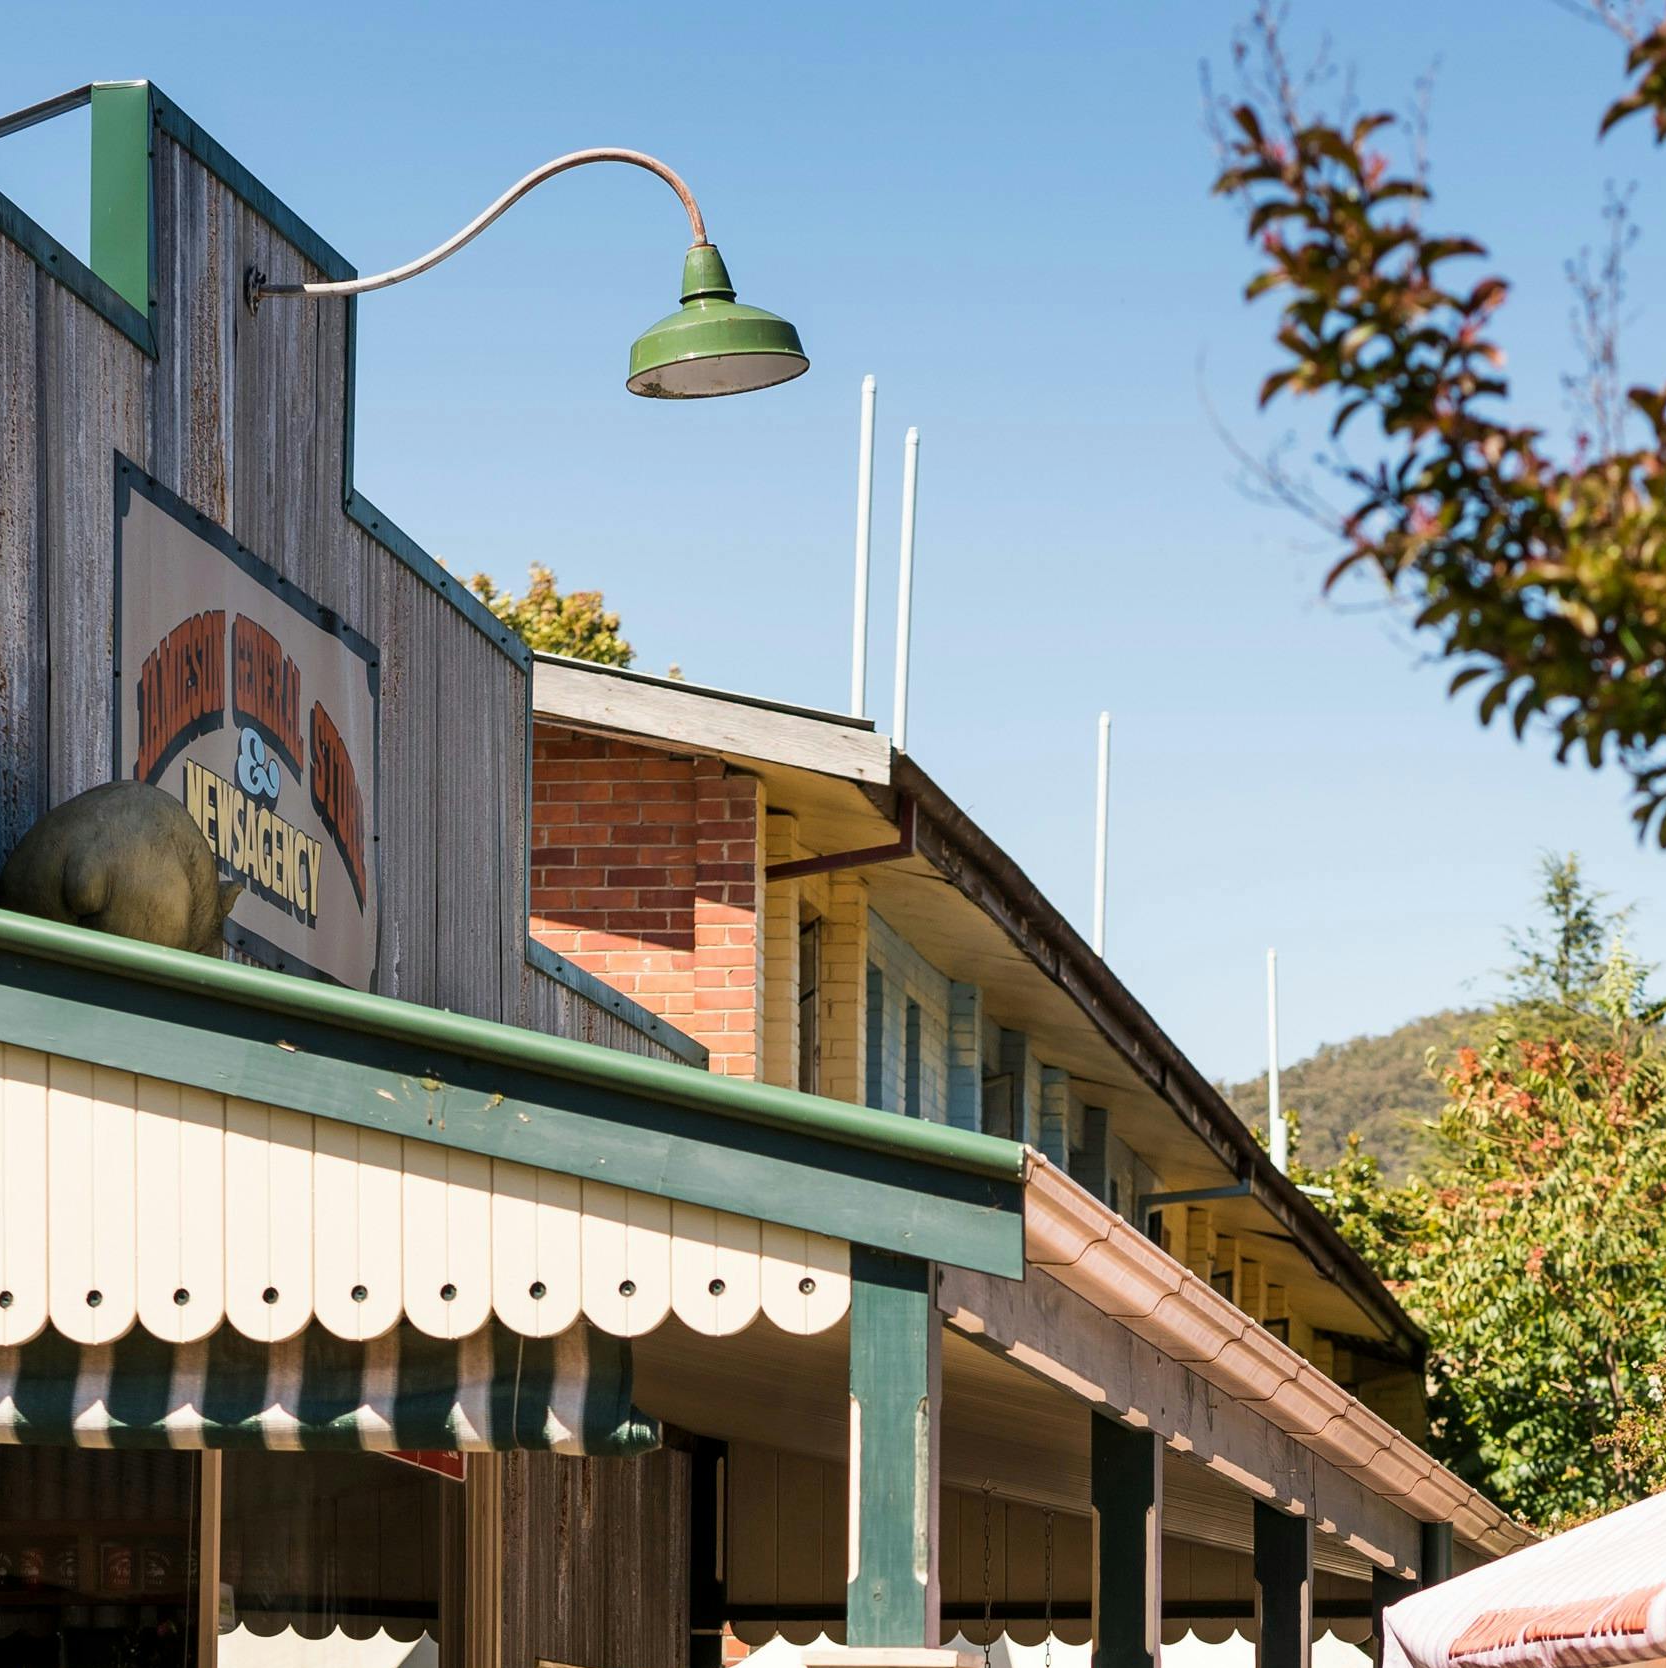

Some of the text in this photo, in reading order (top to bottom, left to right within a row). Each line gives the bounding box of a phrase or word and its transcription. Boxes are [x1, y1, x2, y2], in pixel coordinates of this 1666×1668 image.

[136, 610, 225, 784] JAMIESON
[232, 612, 304, 778] GENERAL
[237, 727, 280, 799] &
[186, 757, 323, 918] NEWSAGENCY
